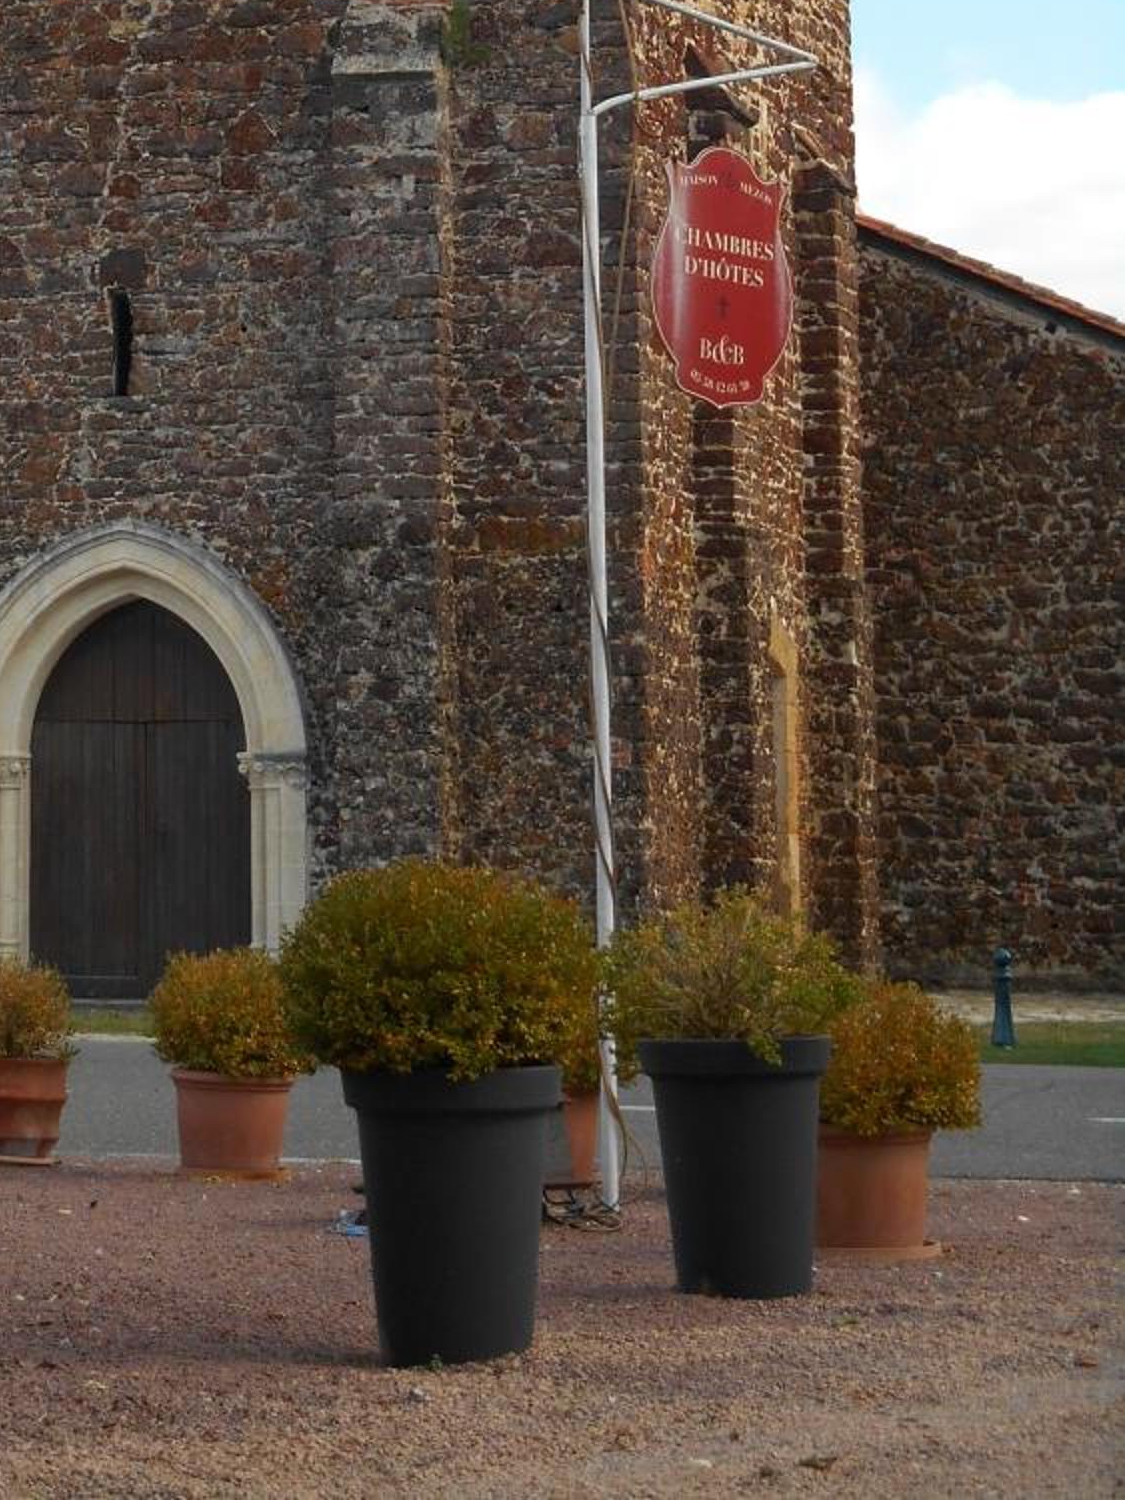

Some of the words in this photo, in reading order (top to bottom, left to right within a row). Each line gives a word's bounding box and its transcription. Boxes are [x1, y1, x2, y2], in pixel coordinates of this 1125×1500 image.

[675, 227, 774, 260] CHAMBRES
[684, 255, 764, 288] D'HÔTES
[699, 334, 745, 365] B&B
